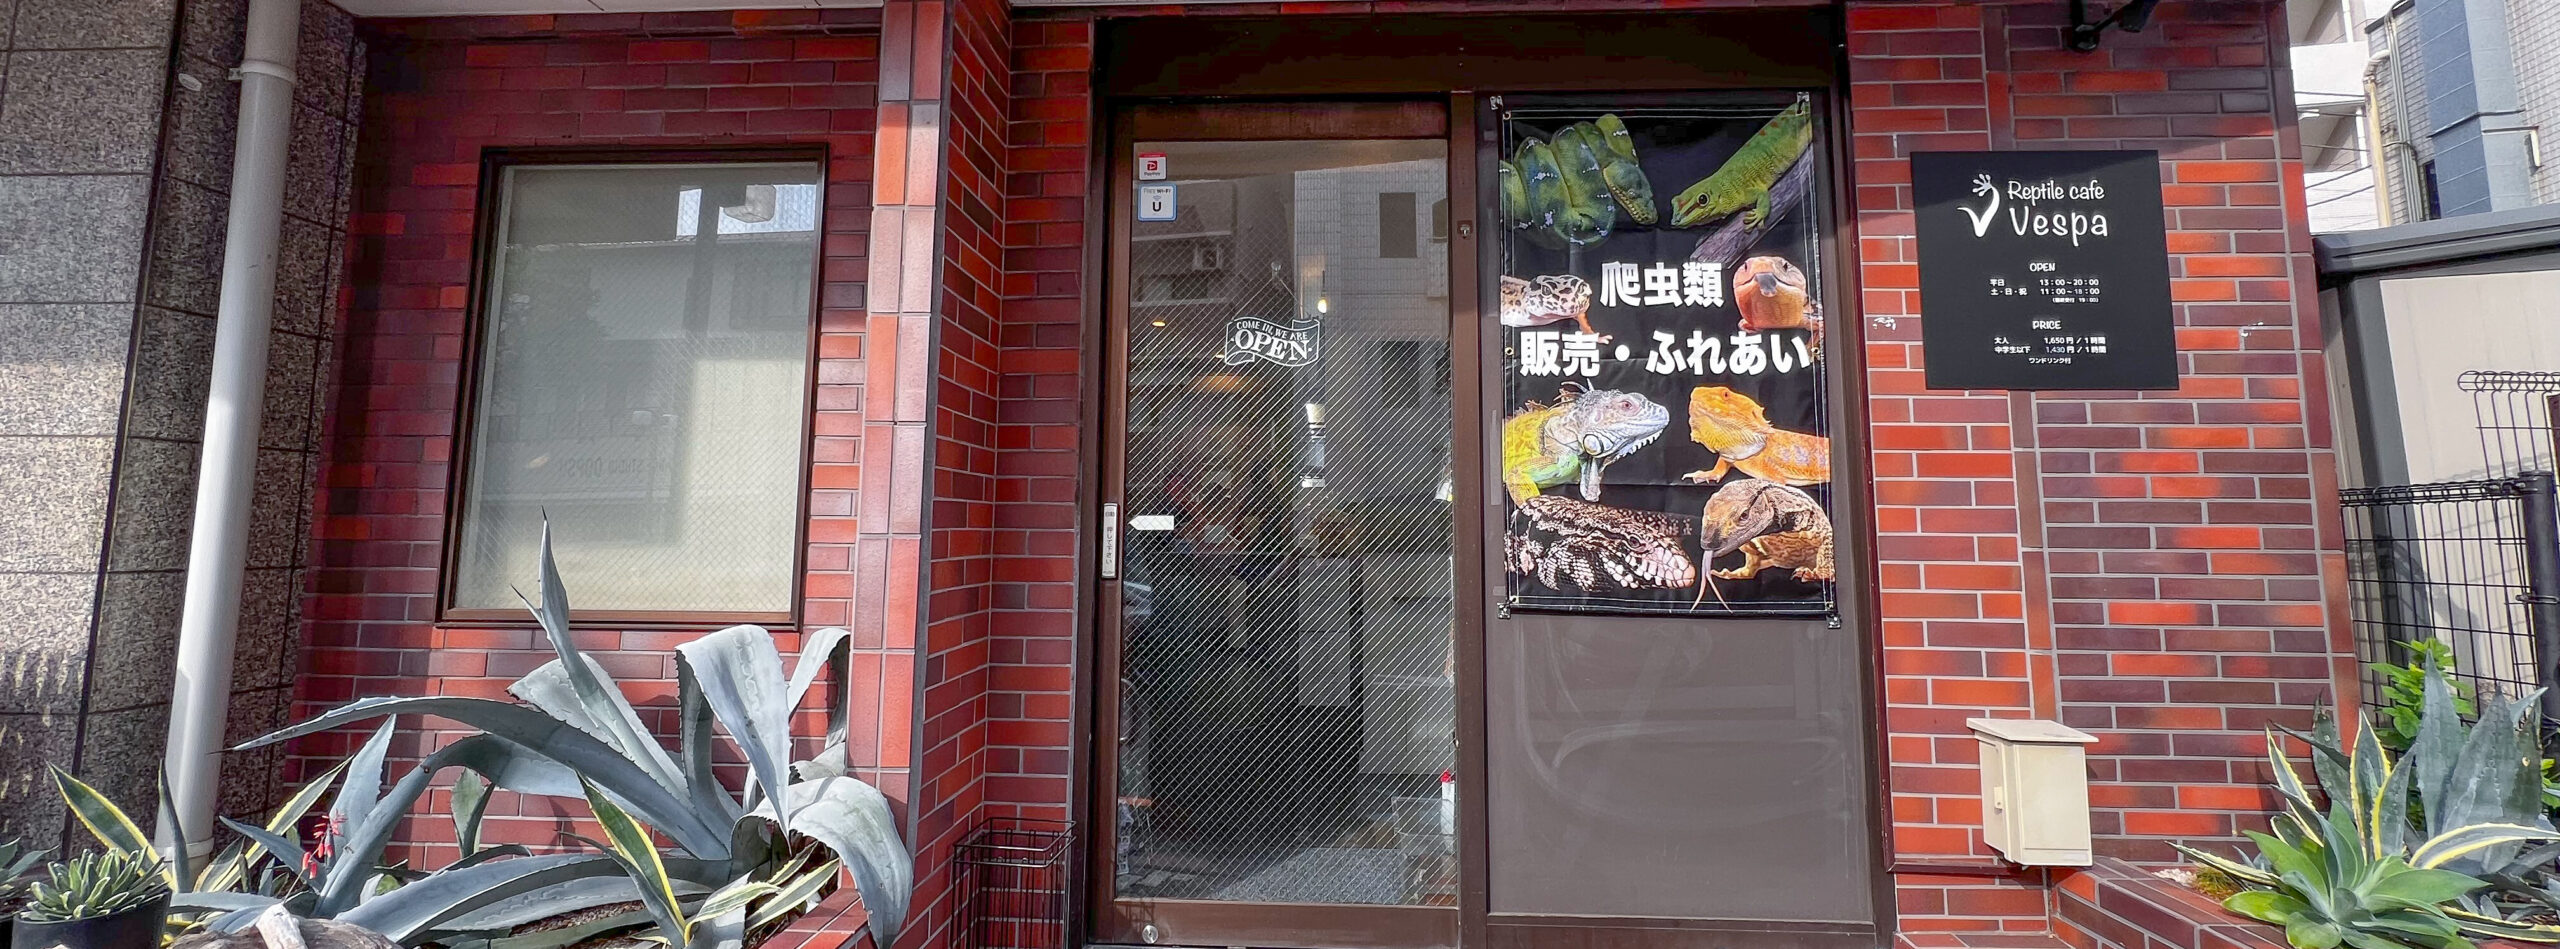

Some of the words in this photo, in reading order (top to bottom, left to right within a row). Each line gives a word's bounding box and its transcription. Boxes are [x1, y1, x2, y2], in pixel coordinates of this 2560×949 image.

[2007, 180, 2064, 206] Reptile
[2069, 179, 2105, 201] cafe
[1152, 201, 1162, 212] U
[2008, 205, 2108, 247] Vespa
[2029, 262, 2056, 272] OPEN
[1599, 260, 1725, 308] 爬虫類
[1989, 278, 2005, 287] 平日
[1236, 320, 1261, 331] COME
[1275, 329, 1288, 340] WE
[1289, 331, 1309, 342] ARE
[2031, 319, 2062, 330] PRICE
[1234, 328, 1310, 361] OPEN
[1993, 336, 2010, 345] 大人
[1519, 329, 1812, 377] 販売・ふれあい
[2028, 357, 2072, 365] ワンドリンク付
